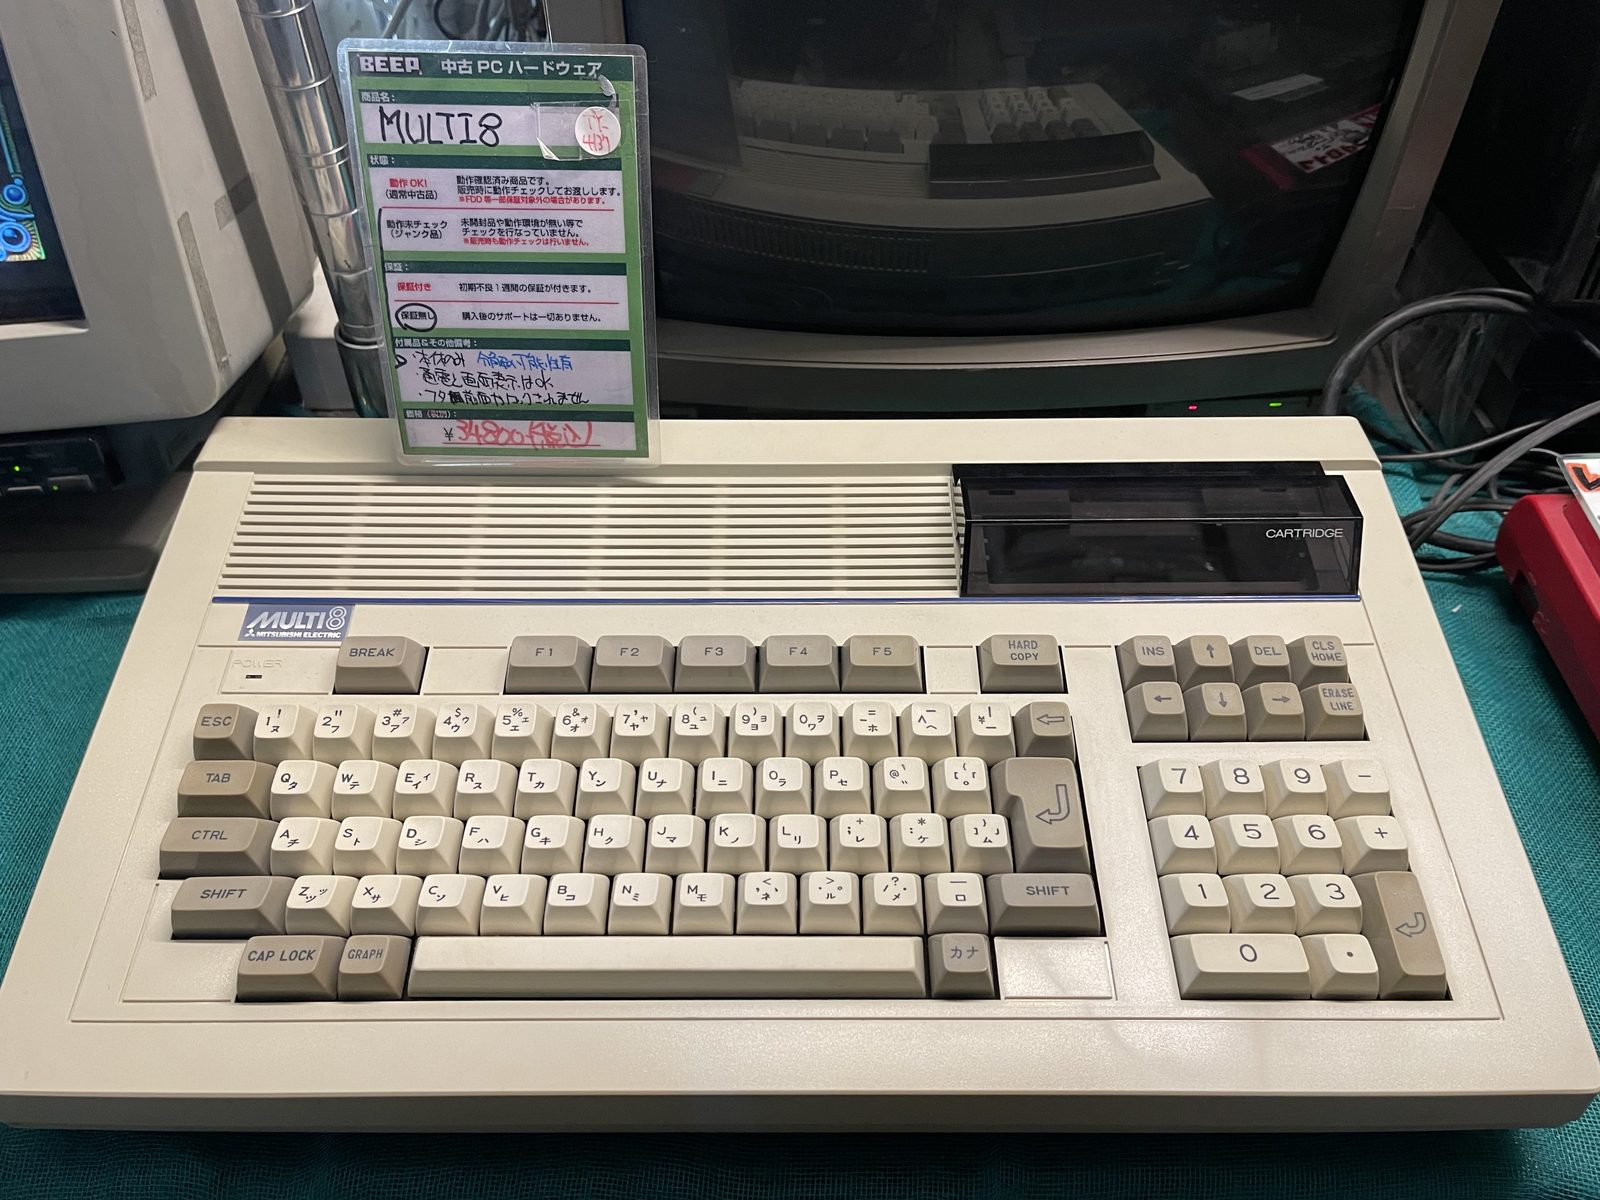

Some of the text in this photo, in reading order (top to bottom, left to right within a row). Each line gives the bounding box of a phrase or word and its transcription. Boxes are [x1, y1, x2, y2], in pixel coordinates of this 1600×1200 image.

[441, 60, 473, 74] 中古
[478, 60, 503, 74] PC
[379, 106, 503, 147] MULTI8
[1266, 528, 1344, 538] CARTRIDGE
[256, 631, 342, 639] MITSUBISHI ELECTRIC
[1009, 640, 1037, 649] HARD
[1312, 641, 1334, 650] CLS
[350, 648, 395, 657] BREAK
[536, 648, 552, 656] F1
[620, 648, 639, 656] F2
[705, 647, 723, 656] F3
[790, 647, 807, 655] F4
[873, 647, 891, 655] F5
[1142, 647, 1164, 655] INS
[1254, 646, 1281, 655] DEL
[1311, 653, 1342, 661] HOME
[231, 659, 283, 669] POWER
[1322, 688, 1354, 697] ERASE
[1330, 702, 1354, 710] LINE
[201, 716, 232, 726] ESC
[266, 717, 270, 725] 1
[322, 717, 332, 726] 2
[382, 716, 393, 727] 3
[443, 717, 454, 728] 4
[503, 716, 511, 725] 5
[563, 715, 571, 725] 6
[623, 715, 630, 724] 7
[682, 714, 690, 724] 8
[742, 715, 750, 724] 9
[800, 715, 807, 724] 0
[207, 773, 230, 782] TAB
[281, 773, 292, 785] Q
[342, 774, 354, 783] W
[405, 773, 415, 782] E
[465, 773, 475, 782] R
[528, 772, 536, 782] T
[589, 771, 600, 782] Y
[648, 771, 659, 783] U
[712, 771, 715, 780] I
[769, 771, 778, 780] O
[830, 770, 838, 779] P
[1172, 768, 1186, 784] 7
[1234, 768, 1250, 784] 8
[1294, 768, 1310, 784] 9
[192, 830, 227, 840] CTRL
[280, 830, 289, 838] A
[343, 829, 353, 837] S
[407, 829, 417, 838] D
[470, 827, 480, 836] F
[531, 828, 540, 837] G
[594, 828, 603, 836] H
[657, 827, 666, 835] J
[720, 827, 728, 836] K
[783, 826, 791, 835] L
[1185, 825, 1199, 840] 4
[1243, 824, 1261, 839] 5
[1308, 825, 1325, 840] 6
[200, 889, 247, 898] SHIFT
[298, 887, 309, 896] Z
[363, 887, 373, 895] X
[429, 886, 440, 897] C
[493, 886, 502, 894] V
[558, 885, 567, 894] B
[622, 885, 632, 894] N
[688, 885, 698, 894] M
[1026, 886, 1069, 895] SHIFT
[1198, 884, 1207, 899] 1
[1260, 884, 1279, 899] 2
[1326, 883, 1345, 900] 3
[248, 950, 316, 961] CAP LOCK
[348, 949, 383, 959] GRAPH
[951, 947, 979, 959] カナ
[1240, 944, 1257, 962] 0
